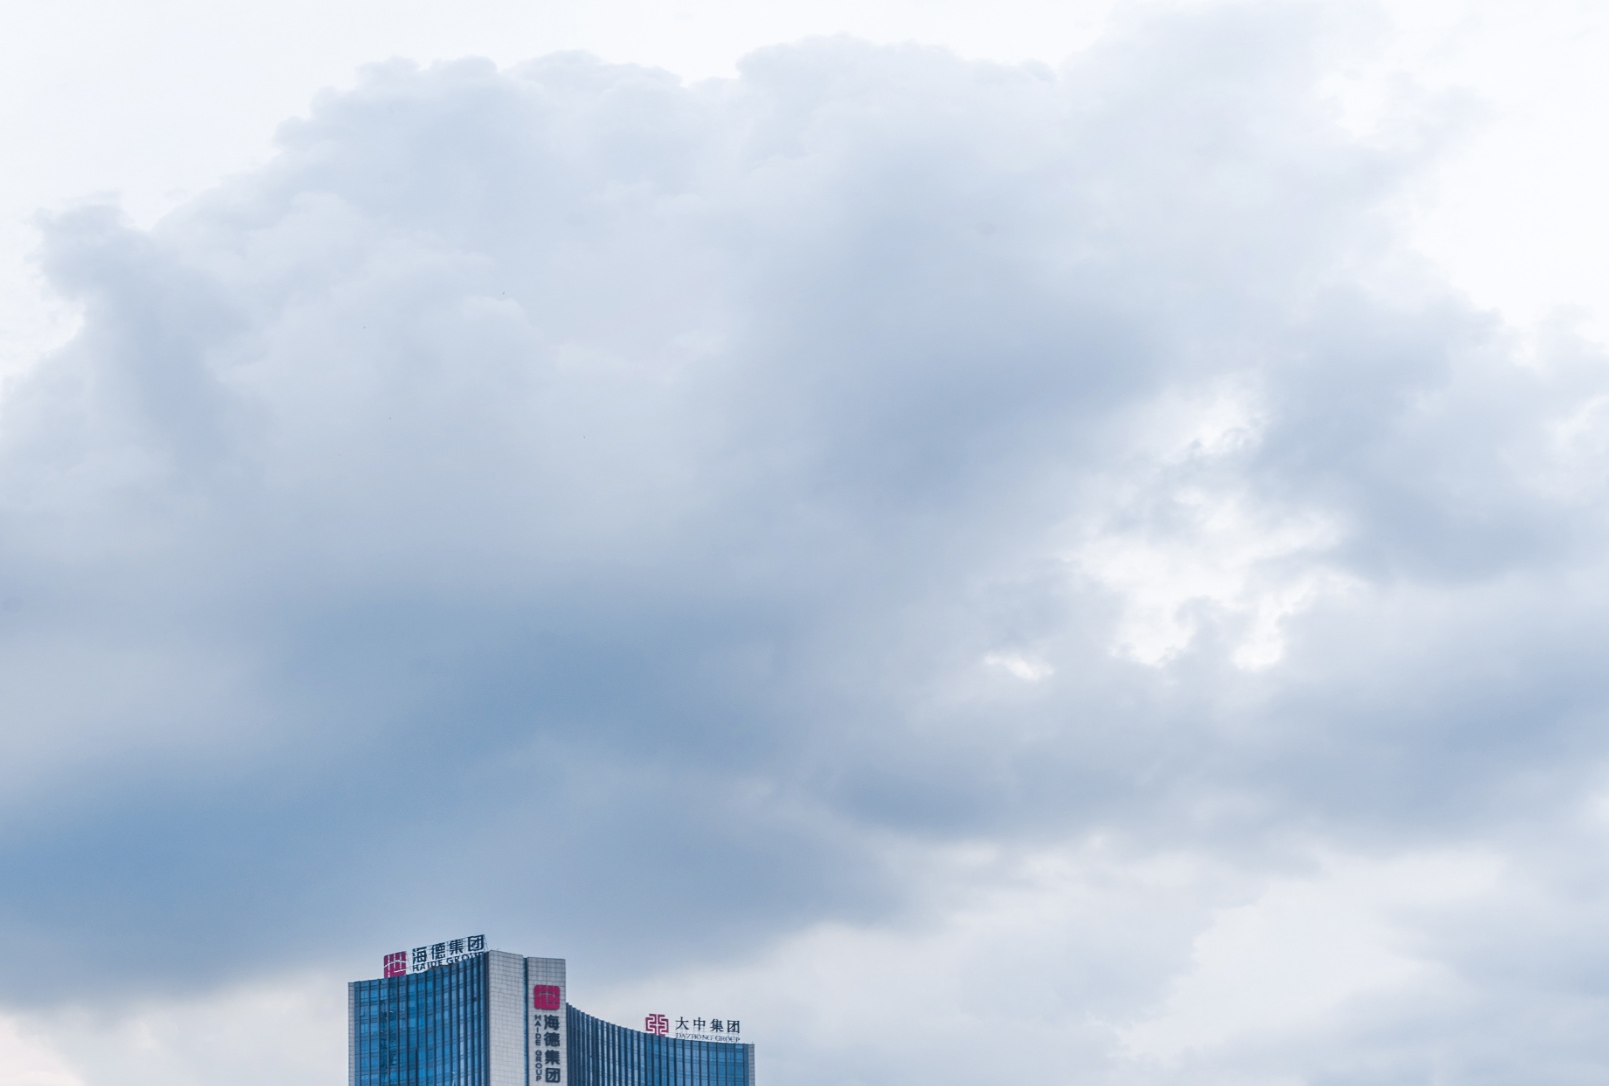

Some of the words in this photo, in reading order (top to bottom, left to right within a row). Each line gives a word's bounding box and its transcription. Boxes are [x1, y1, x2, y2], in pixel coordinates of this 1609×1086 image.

[412, 934, 485, 964] 海德集团
[675, 1016, 740, 1033] 大中集团
[544, 1014, 561, 1083] 海德集团
